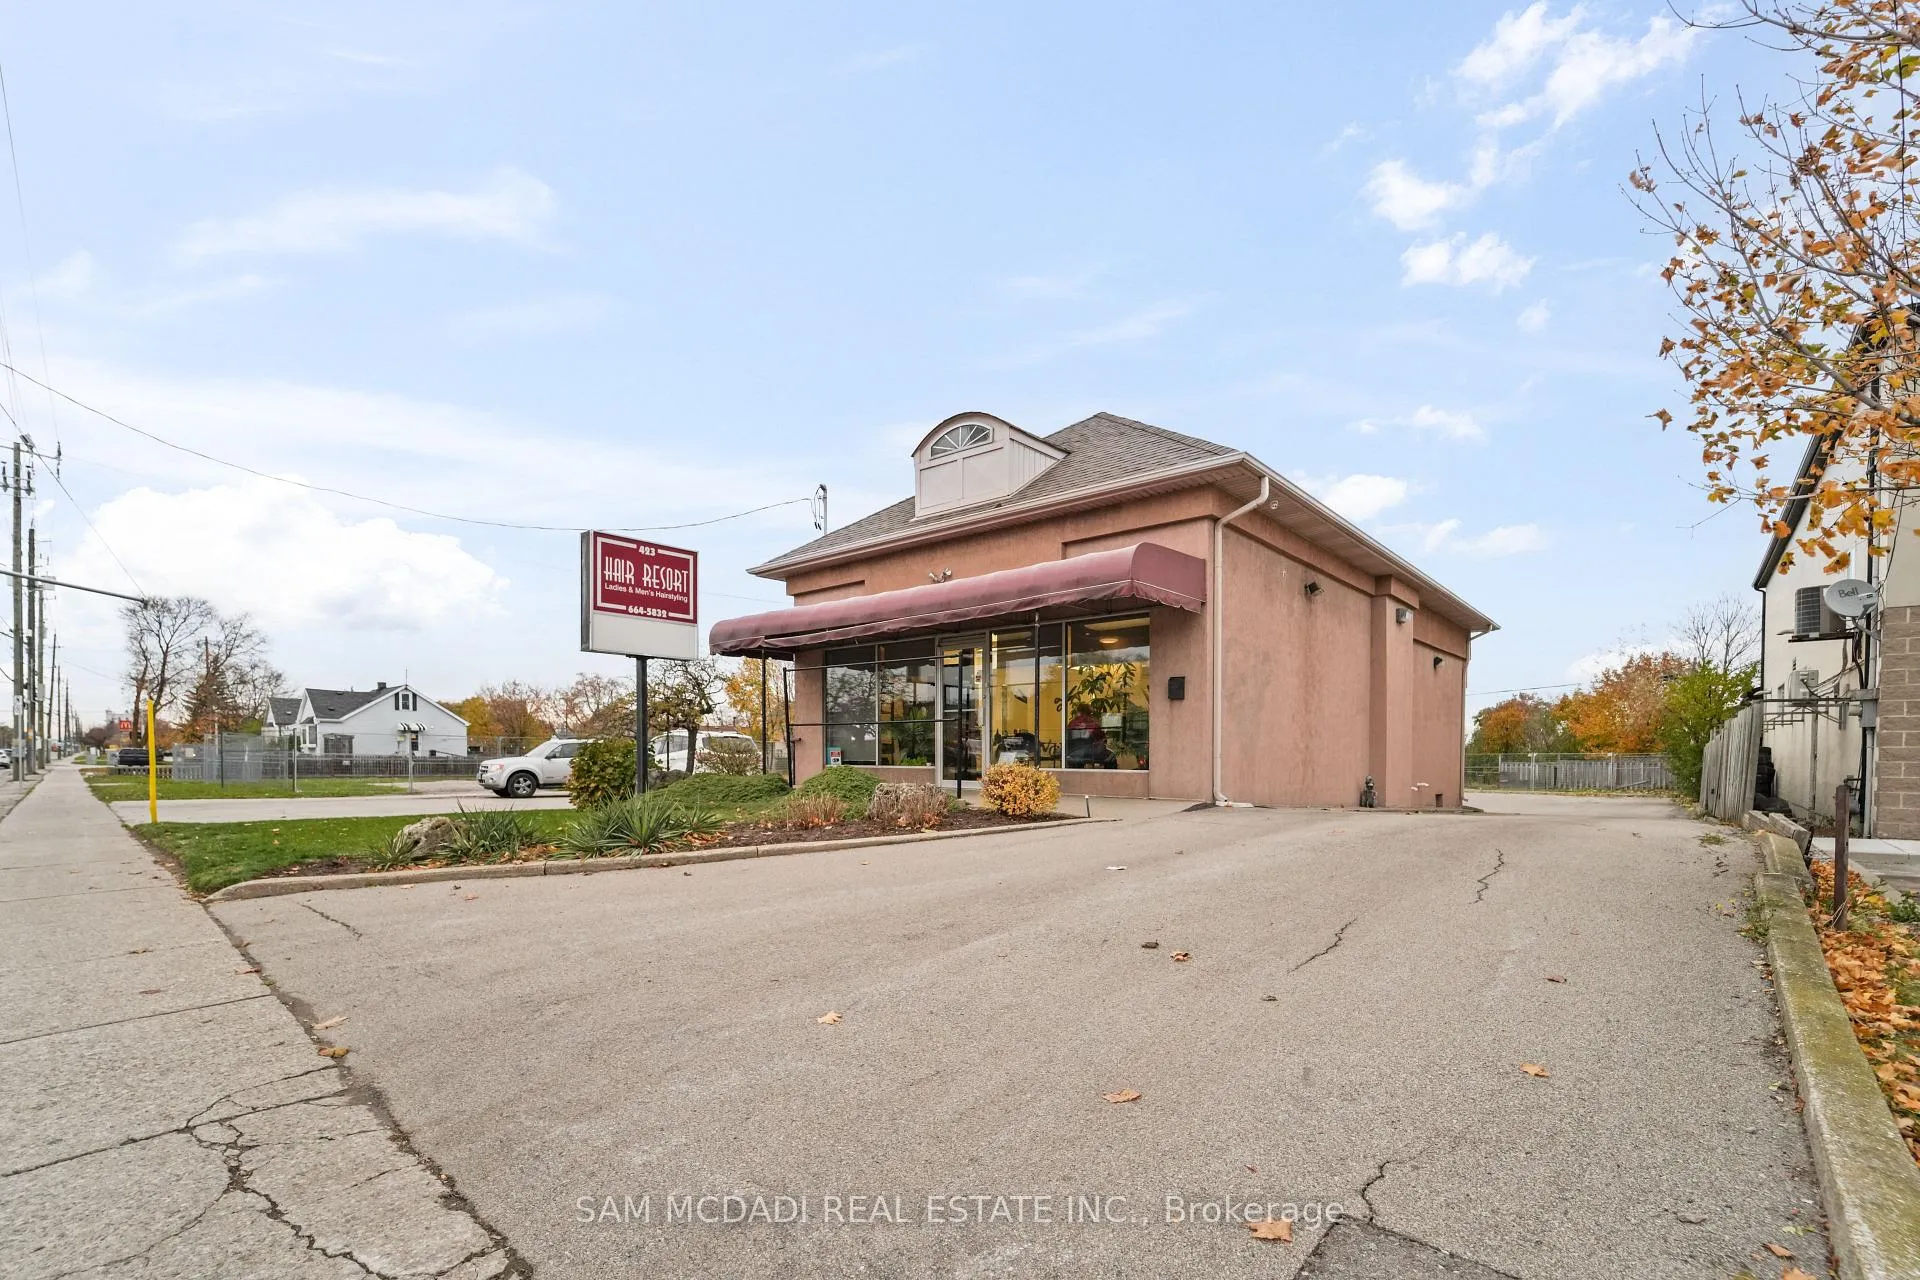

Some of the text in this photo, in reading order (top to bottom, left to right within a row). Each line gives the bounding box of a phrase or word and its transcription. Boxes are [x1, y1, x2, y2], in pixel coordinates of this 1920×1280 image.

[638, 545, 656, 556] 423
[604, 556, 689, 593] HAIR RESORT
[604, 583, 627, 592] Ladies
[635, 587, 654, 596] Men's
[656, 592, 688, 603] Hairstyling
[1838, 586, 1859, 598] Bell
[628, 605, 667, 617] 664-5832
